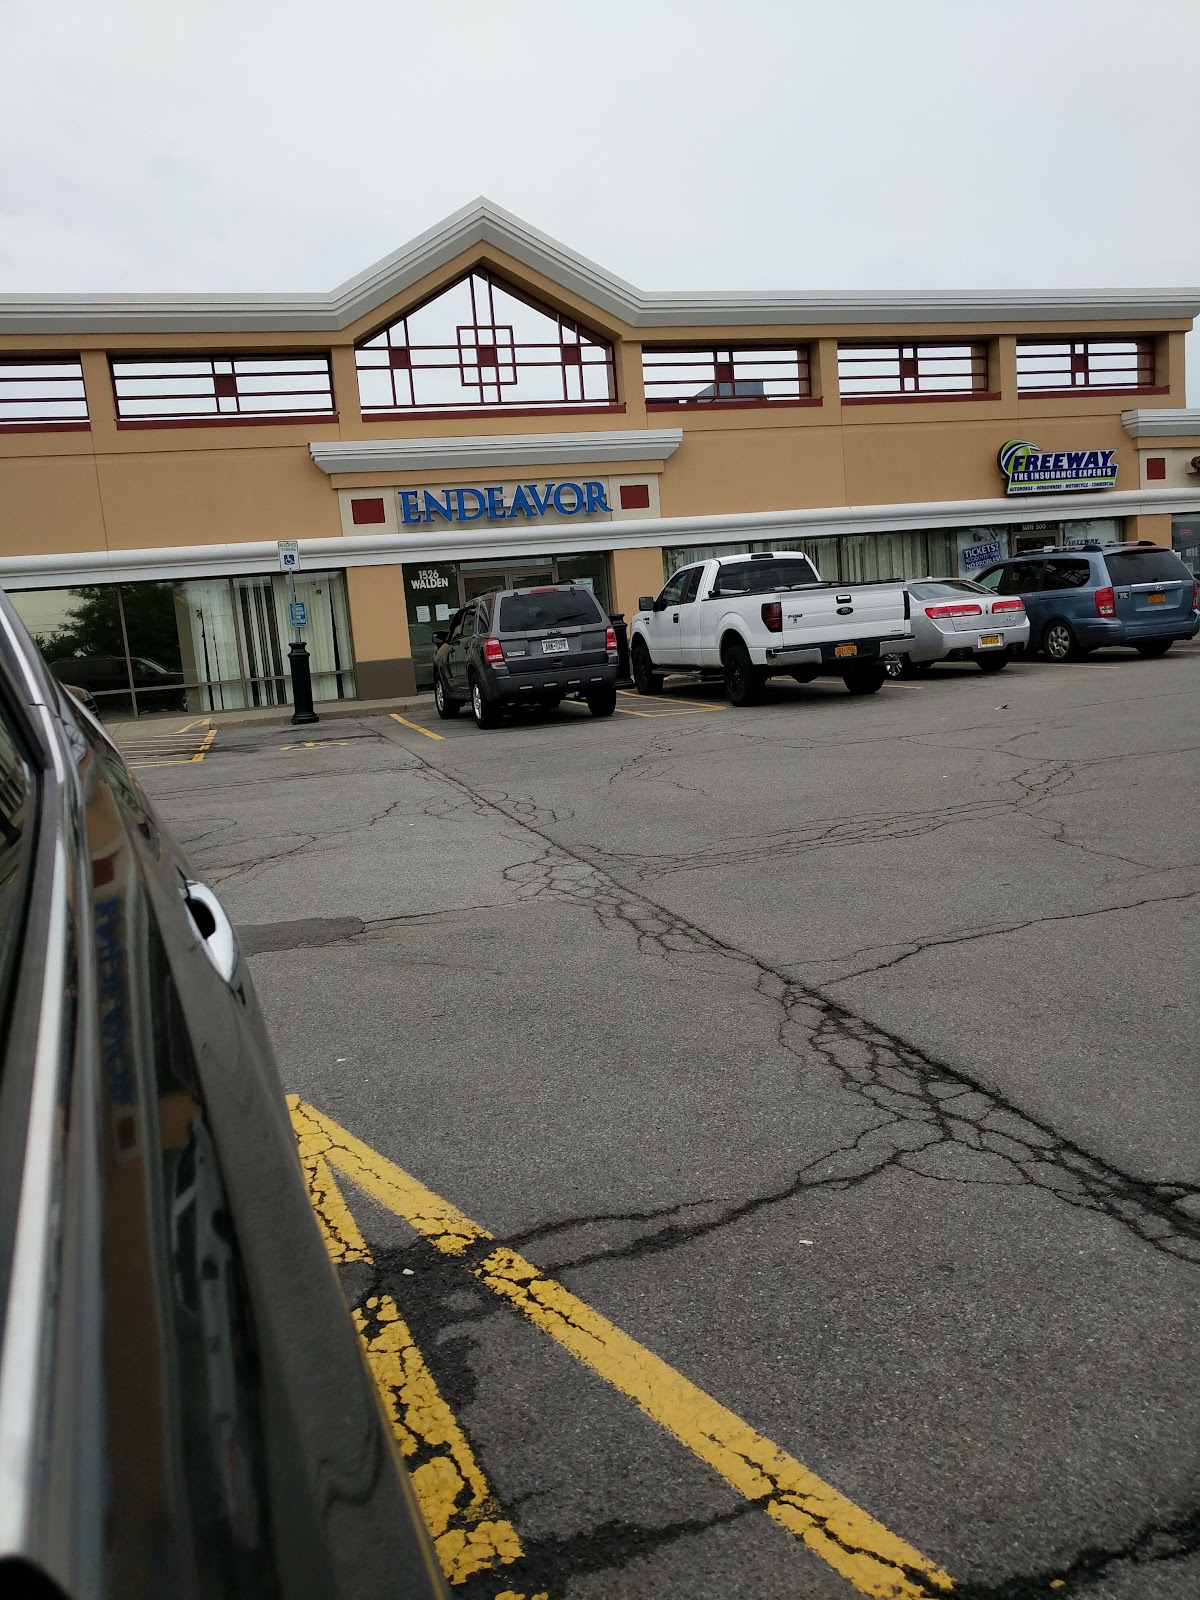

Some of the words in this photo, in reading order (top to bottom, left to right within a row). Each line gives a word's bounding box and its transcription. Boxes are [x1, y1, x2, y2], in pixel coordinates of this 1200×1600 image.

[1012, 450, 1115, 471] FREEWAY
[1014, 472, 1028, 481] THE
[1030, 470, 1076, 480] INSURANCE
[1079, 468, 1112, 478] EXPERTS
[398, 481, 614, 524] ENDEAVOR
[964, 542, 999, 558] TICKETS?
[966, 562, 976, 570] NO
[418, 569, 439, 580] 1526
[410, 577, 449, 590] WALDEN
